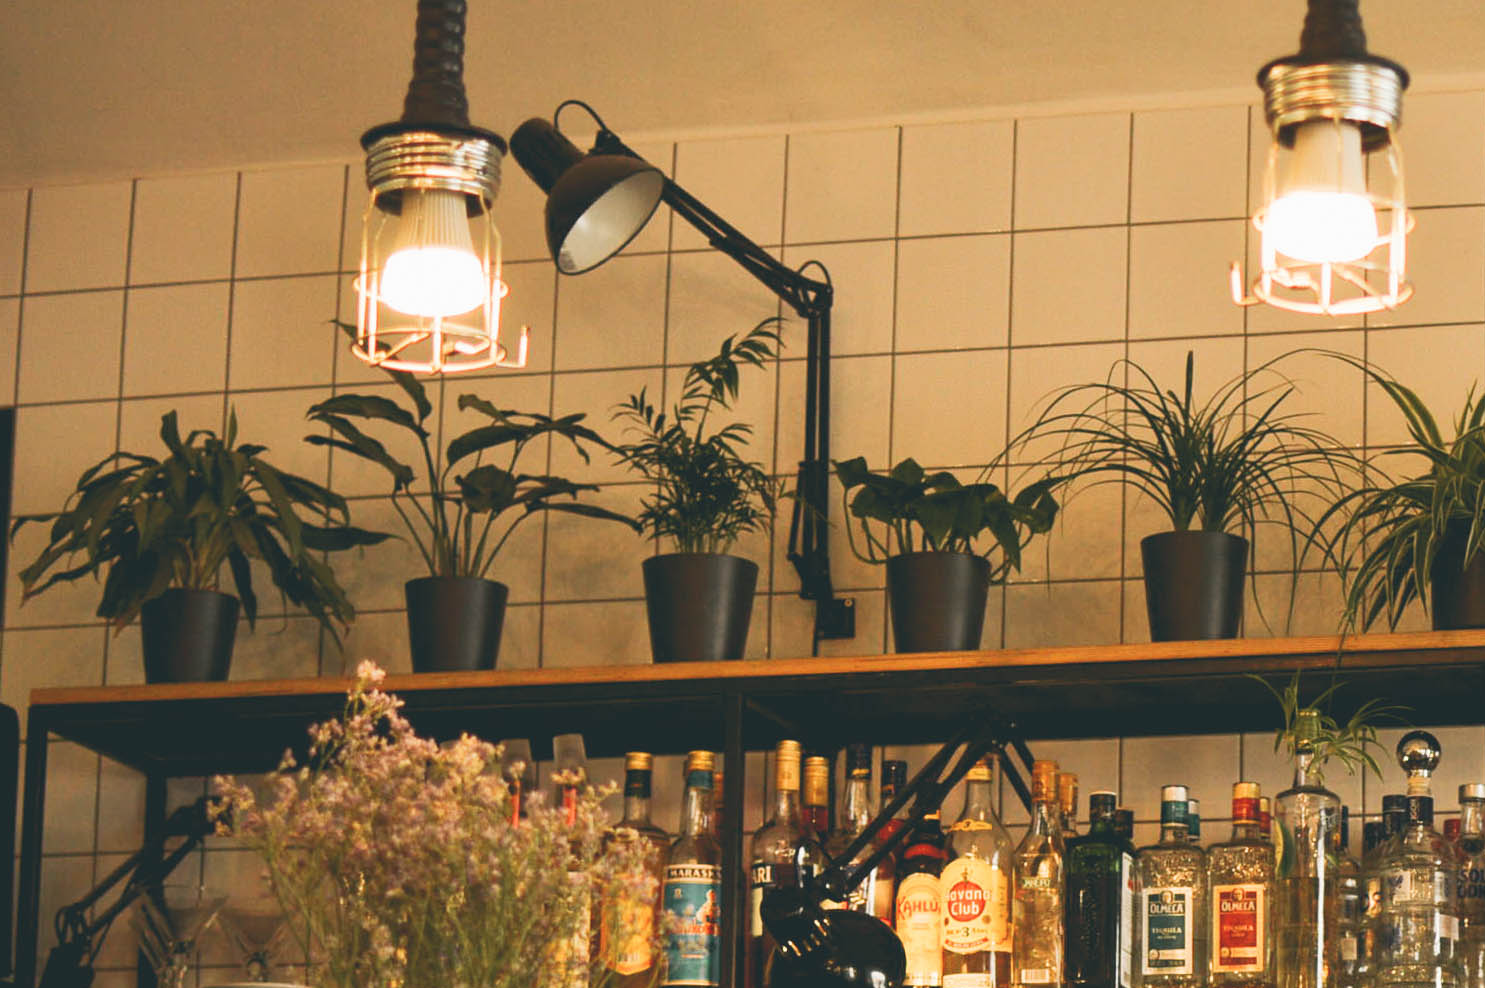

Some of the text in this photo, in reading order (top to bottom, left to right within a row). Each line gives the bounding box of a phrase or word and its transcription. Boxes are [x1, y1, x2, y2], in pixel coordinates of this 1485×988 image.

[897, 896, 941, 920] KAHLU
[951, 901, 980, 915] Club
[1150, 903, 1184, 914] OLMECA
[1221, 901, 1256, 912] OLMECA
